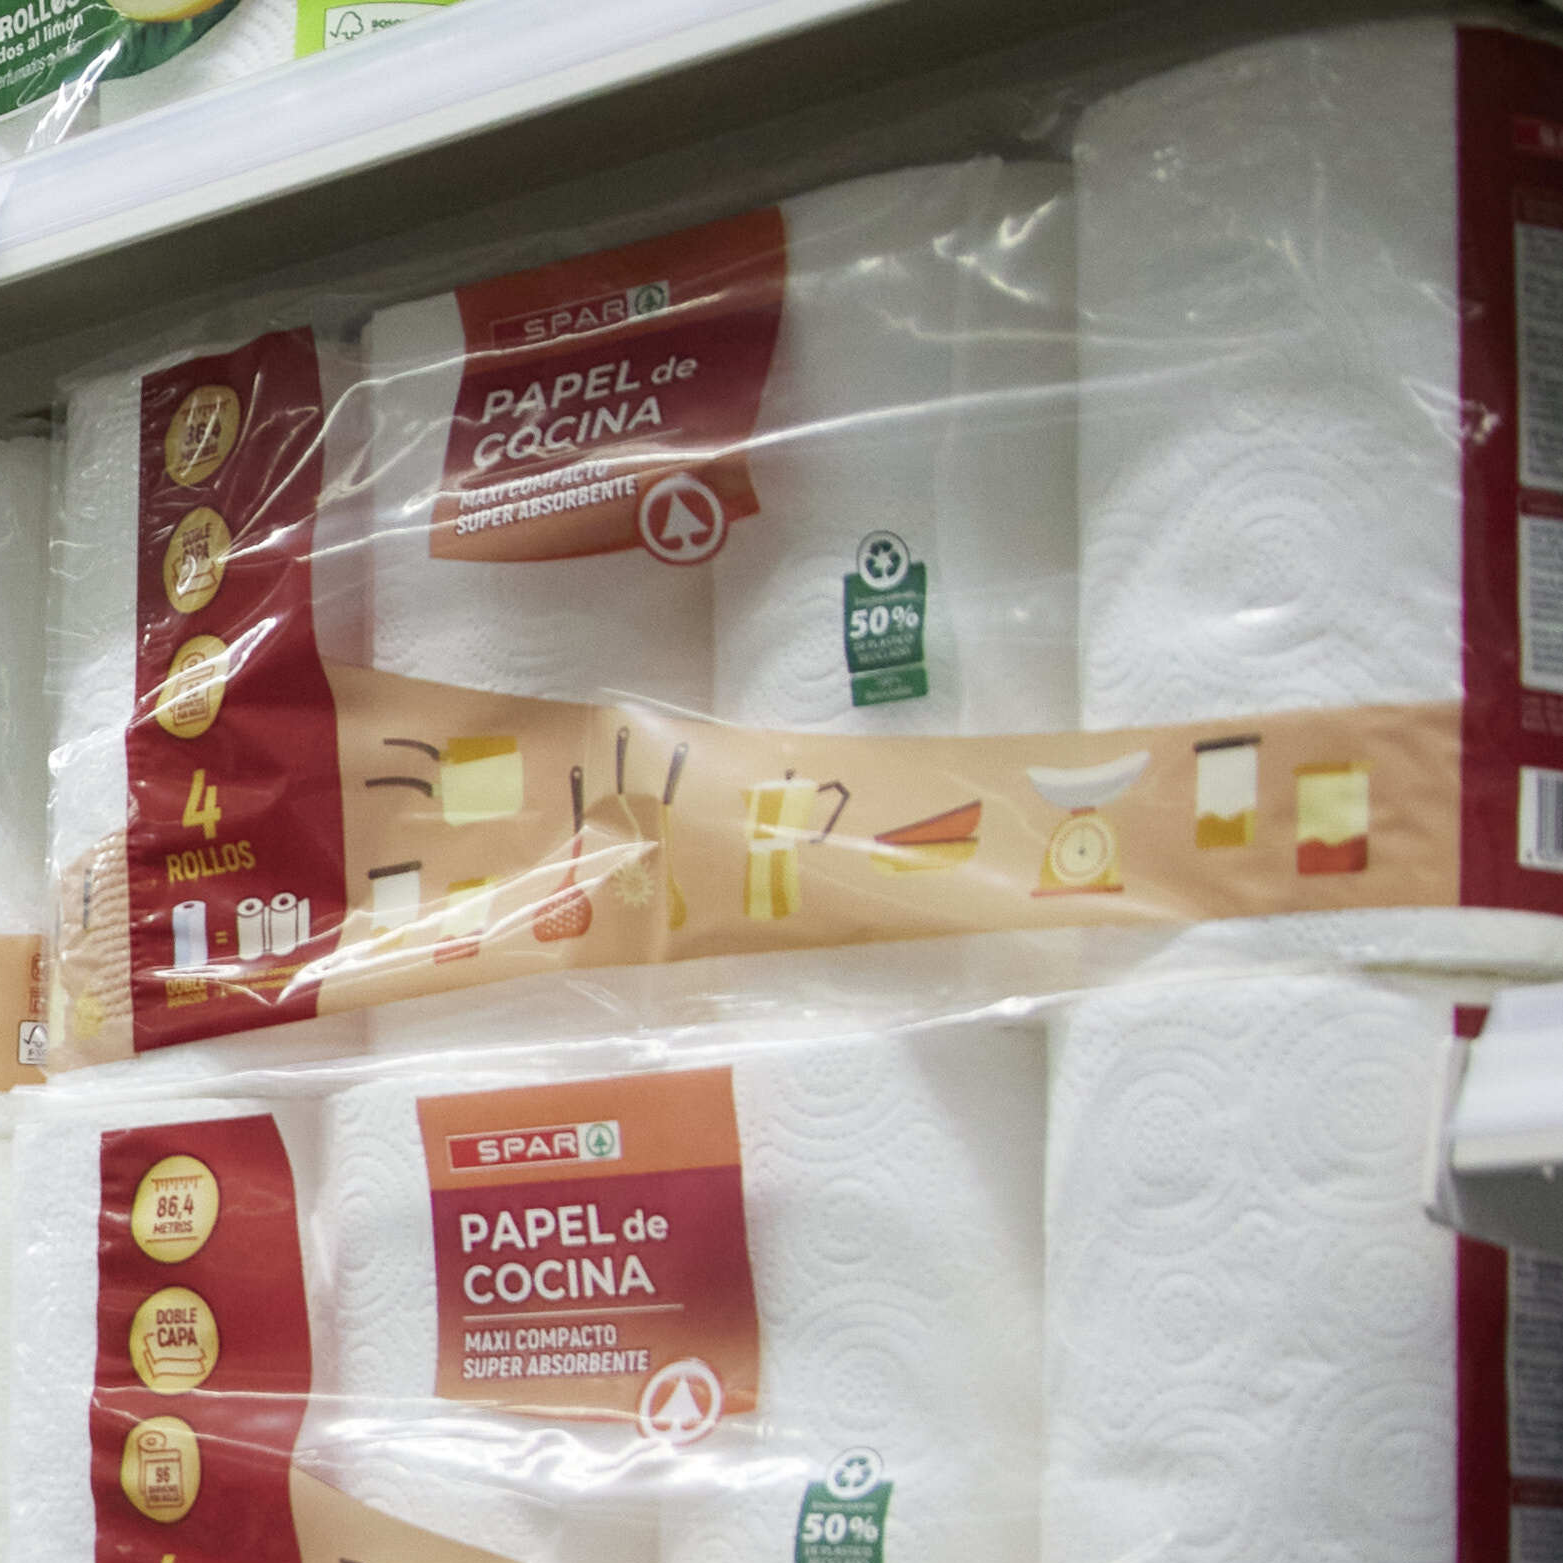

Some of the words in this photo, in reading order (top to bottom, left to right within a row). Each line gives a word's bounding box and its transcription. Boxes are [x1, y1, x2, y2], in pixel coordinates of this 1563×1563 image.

[27, 34, 40, 52] al
[43, 12, 84, 43] limón
[523, 300, 626, 343] SPAR
[481, 358, 641, 424] PAPEL
[650, 356, 699, 386] de
[471, 396, 664, 471] COCINA
[455, 504, 514, 536] SUPER
[517, 474, 638, 522] ABSORBENTE
[848, 603, 921, 639] 50%
[181, 769, 222, 840] 4
[167, 839, 257, 885] ROLLOS
[476, 1131, 578, 1163] SPAR
[156, 1195, 194, 1220] 86,4
[153, 1220, 194, 1235] METROS
[459, 1203, 616, 1253] PAPEL
[622, 1208, 670, 1242] de
[462, 1254, 657, 1305] COCINA
[155, 1307, 198, 1326] DOBLE
[157, 1326, 198, 1349] CAPA
[464, 1330, 511, 1353] MAXI
[515, 1324, 617, 1350] COMPACTO
[463, 1355, 523, 1380] SUPER
[526, 1350, 649, 1376] ABSORBENTE
[801, 1511, 880, 1545] 50%
